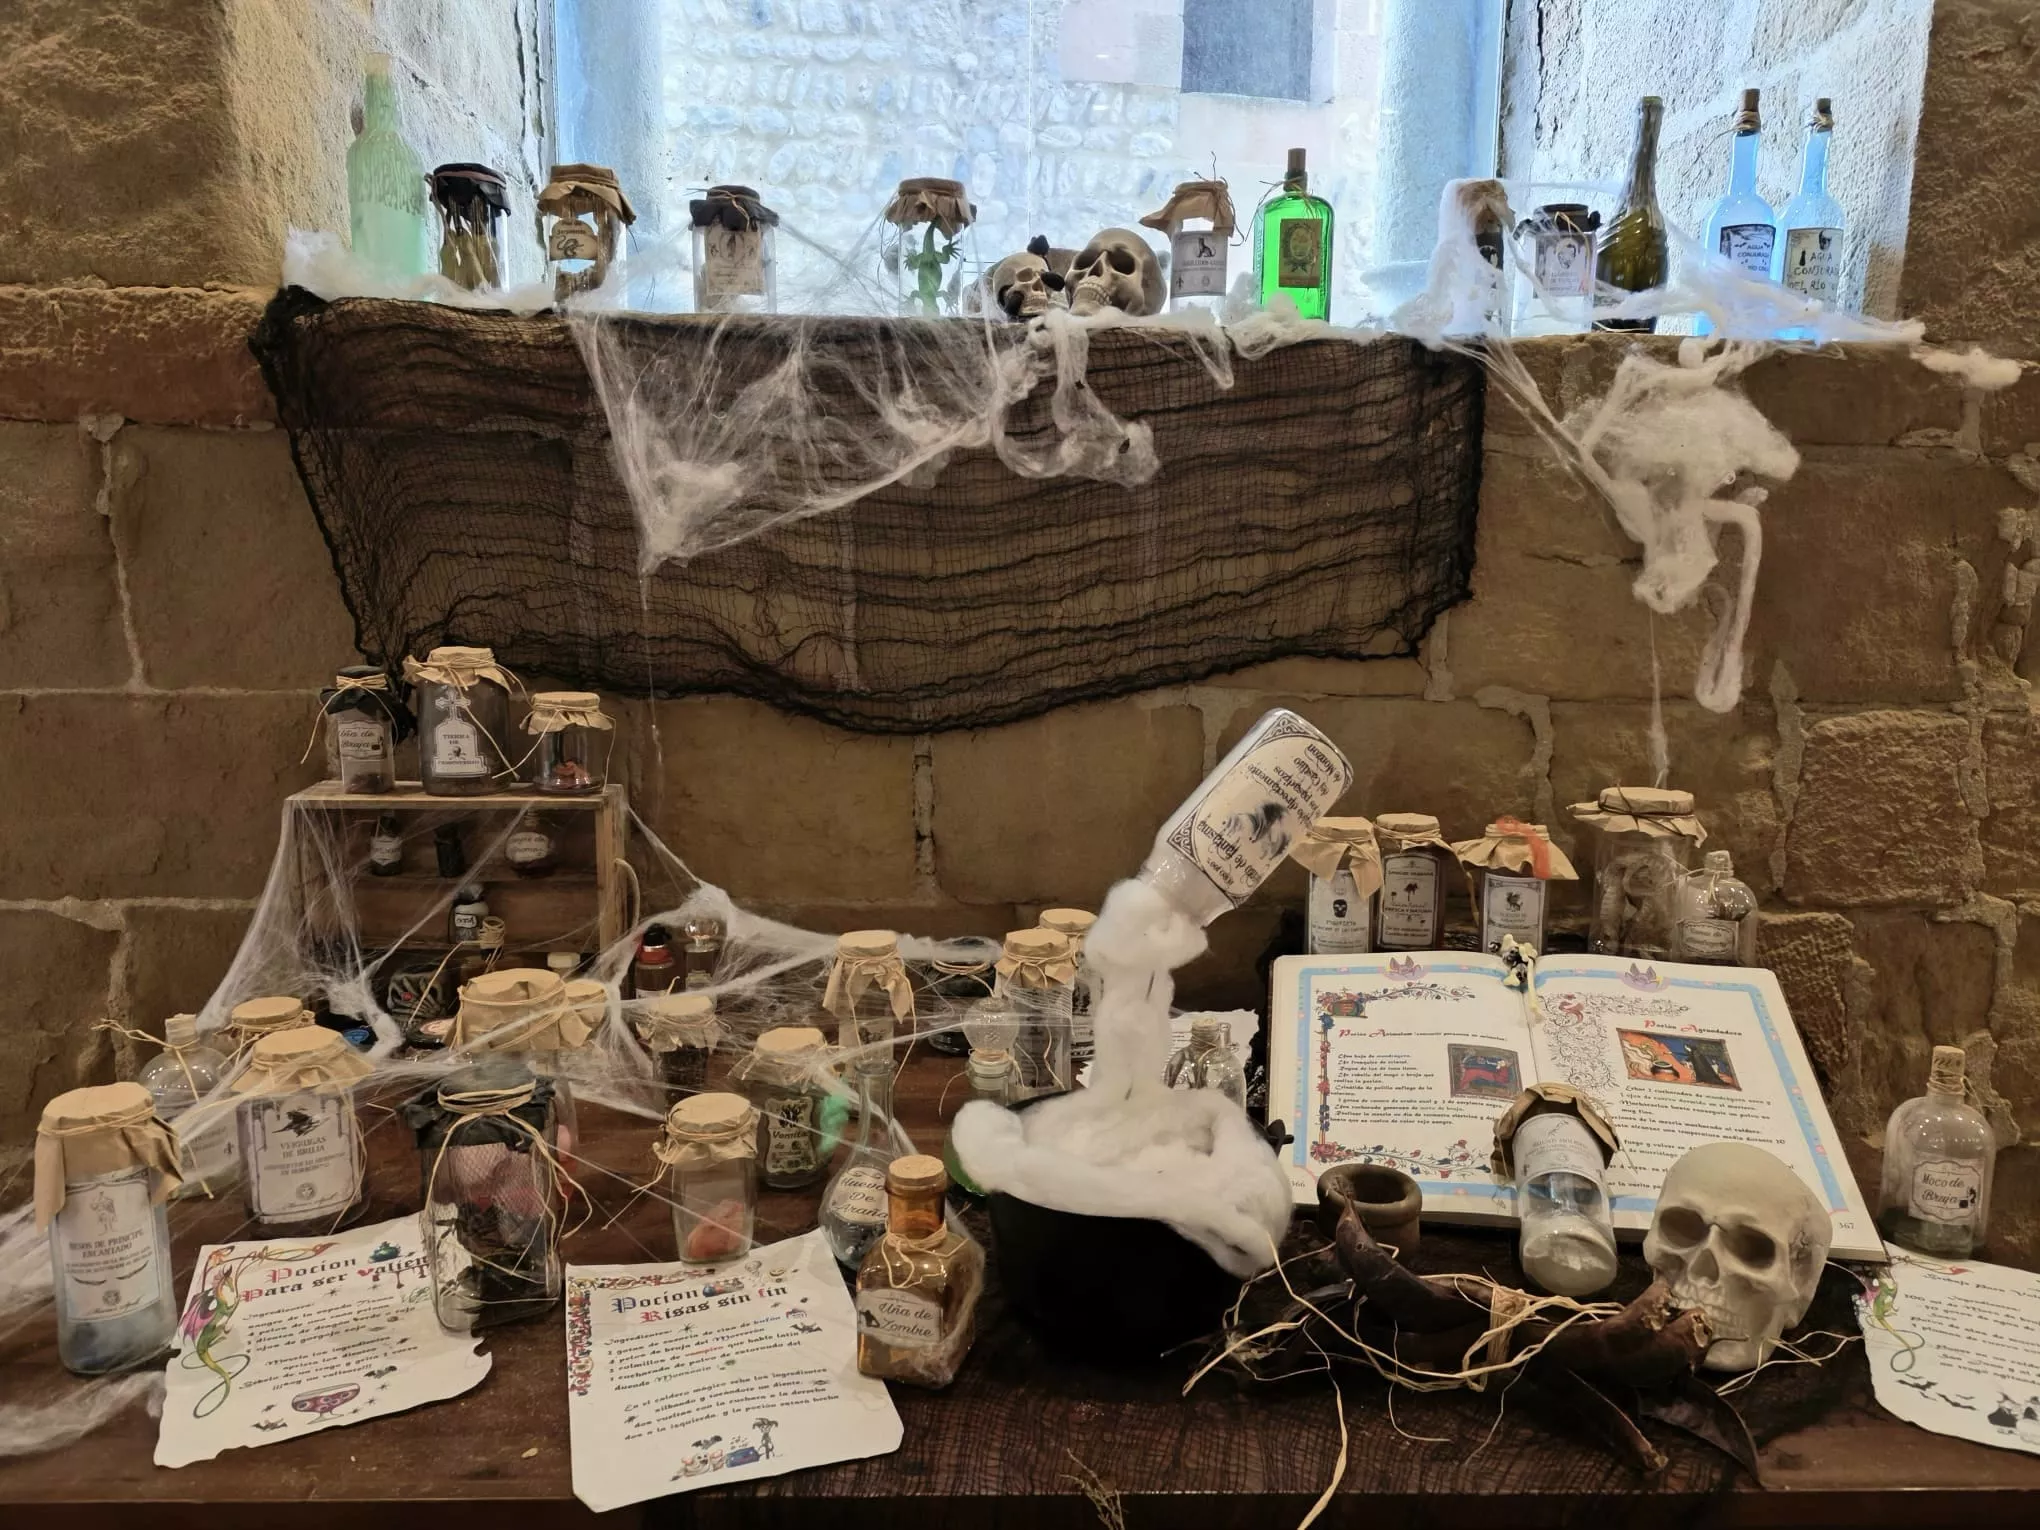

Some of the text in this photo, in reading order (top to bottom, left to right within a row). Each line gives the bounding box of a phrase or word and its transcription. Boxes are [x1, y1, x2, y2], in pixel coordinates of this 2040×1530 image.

[1293, 757, 1321, 786] Castillo
[1247, 764, 1298, 811] directamente
[1273, 766, 1314, 803] pasadizos
[1196, 819, 1248, 869] de fantasma
[282, 1145, 325, 1160] DE BRUJA
[1922, 1172, 1965, 1188] Moco de
[849, 1192, 876, 1203] De
[1922, 1188, 1958, 1205] Bruja
[834, 1203, 889, 1218] Araña
[239, 1282, 303, 1303] Para
[311, 1272, 348, 1288] ser
[639, 1285, 788, 1324] Risas sin fin
[878, 1302, 934, 1321] Uña de
[879, 1317, 935, 1337] Zombie
[604, 1330, 672, 1346] Ingredientes:
[664, 1344, 691, 1352] bruja
[618, 1359, 666, 1370] colmillos
[685, 1346, 724, 1357] vampiro
[727, 1341, 744, 1349] que
[618, 1366, 670, 1380] cucharada
[689, 1356, 717, 1366] polvo
[654, 1391, 690, 1403] caldero
[696, 1404, 712, 1412] con
[729, 1395, 766, 1404] cuchara
[791, 1384, 826, 1395] derecha
